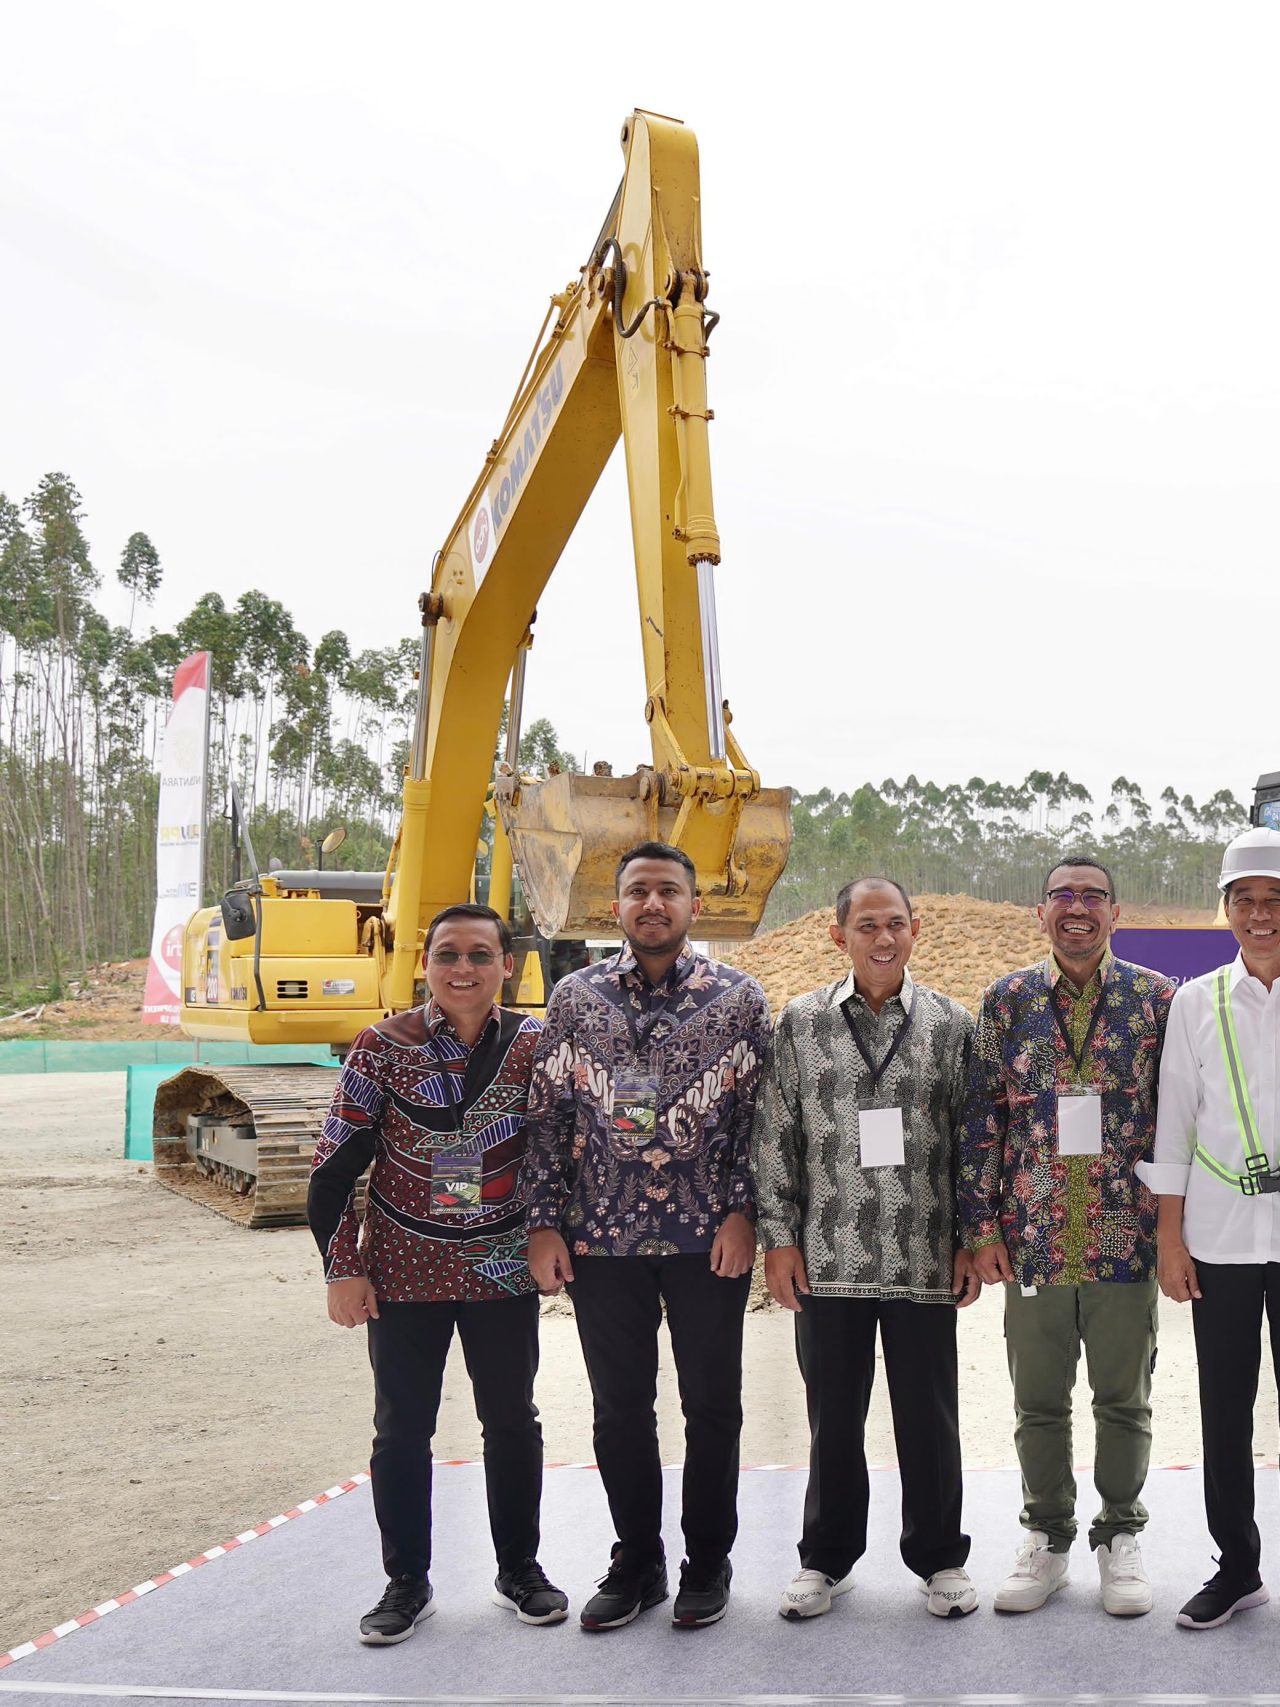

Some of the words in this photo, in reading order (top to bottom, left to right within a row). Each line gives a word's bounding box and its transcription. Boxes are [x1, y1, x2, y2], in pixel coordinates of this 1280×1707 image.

[490, 358, 564, 535] KOMATSU
[623, 1106, 646, 1117] VIP
[445, 1182, 469, 1192] VIP
